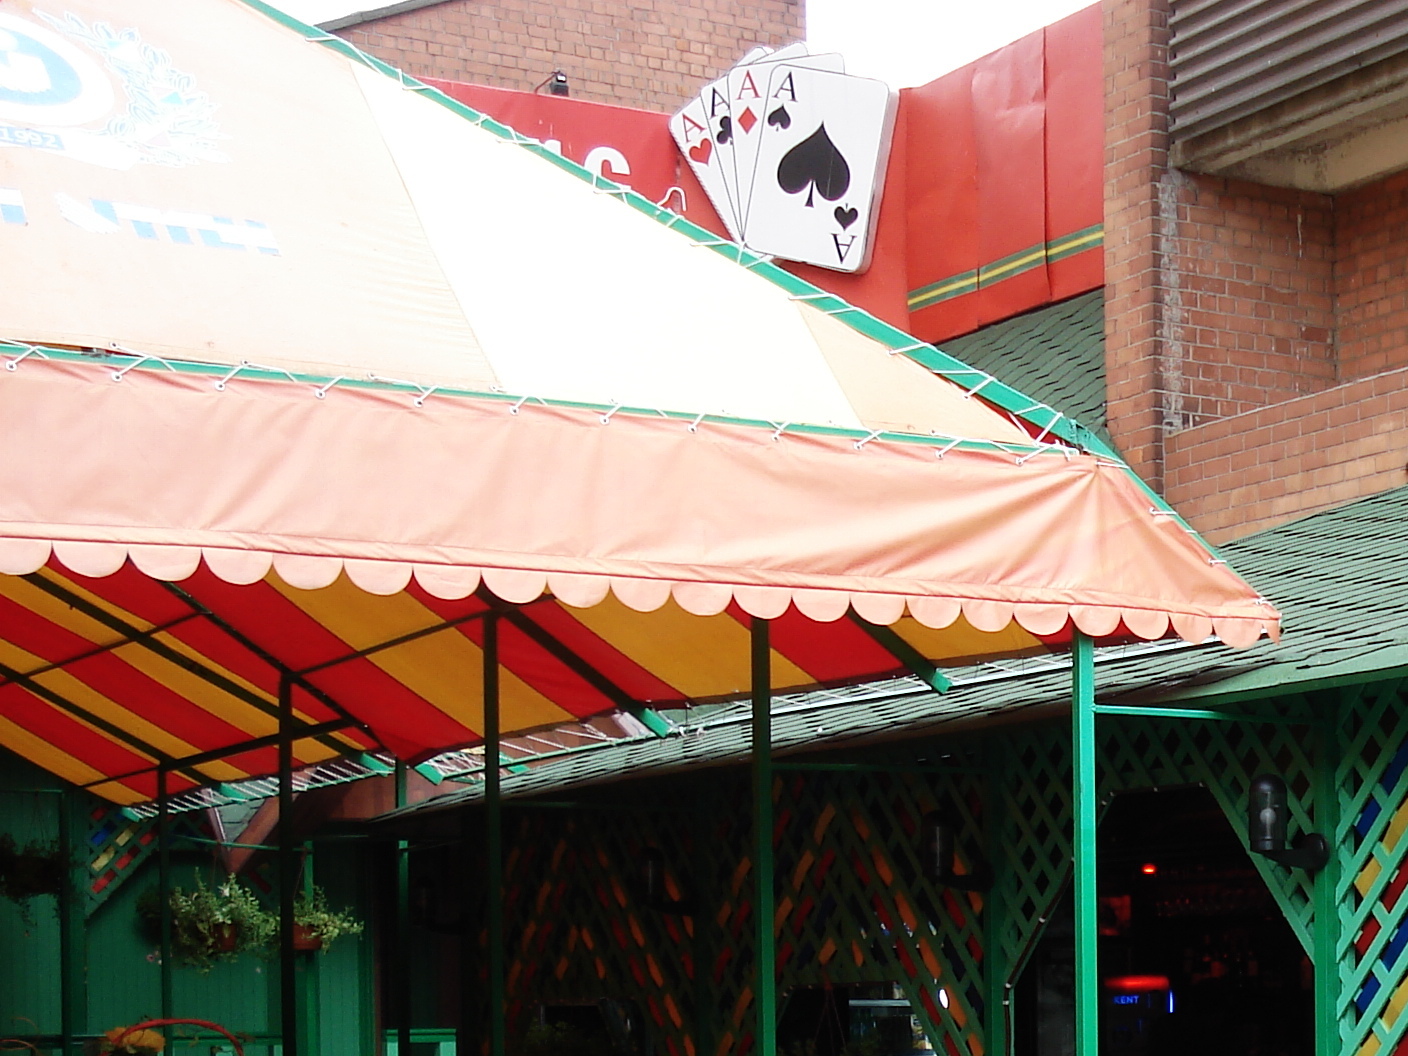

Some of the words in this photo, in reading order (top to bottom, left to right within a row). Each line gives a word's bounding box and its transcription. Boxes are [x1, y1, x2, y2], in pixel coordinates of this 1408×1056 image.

[737, 71, 761, 100] A
[773, 72, 799, 102] A
[709, 87, 731, 119] A
[0, 127, 59, 149] 1992
[681, 113, 705, 142] A
[830, 233, 857, 264] A
